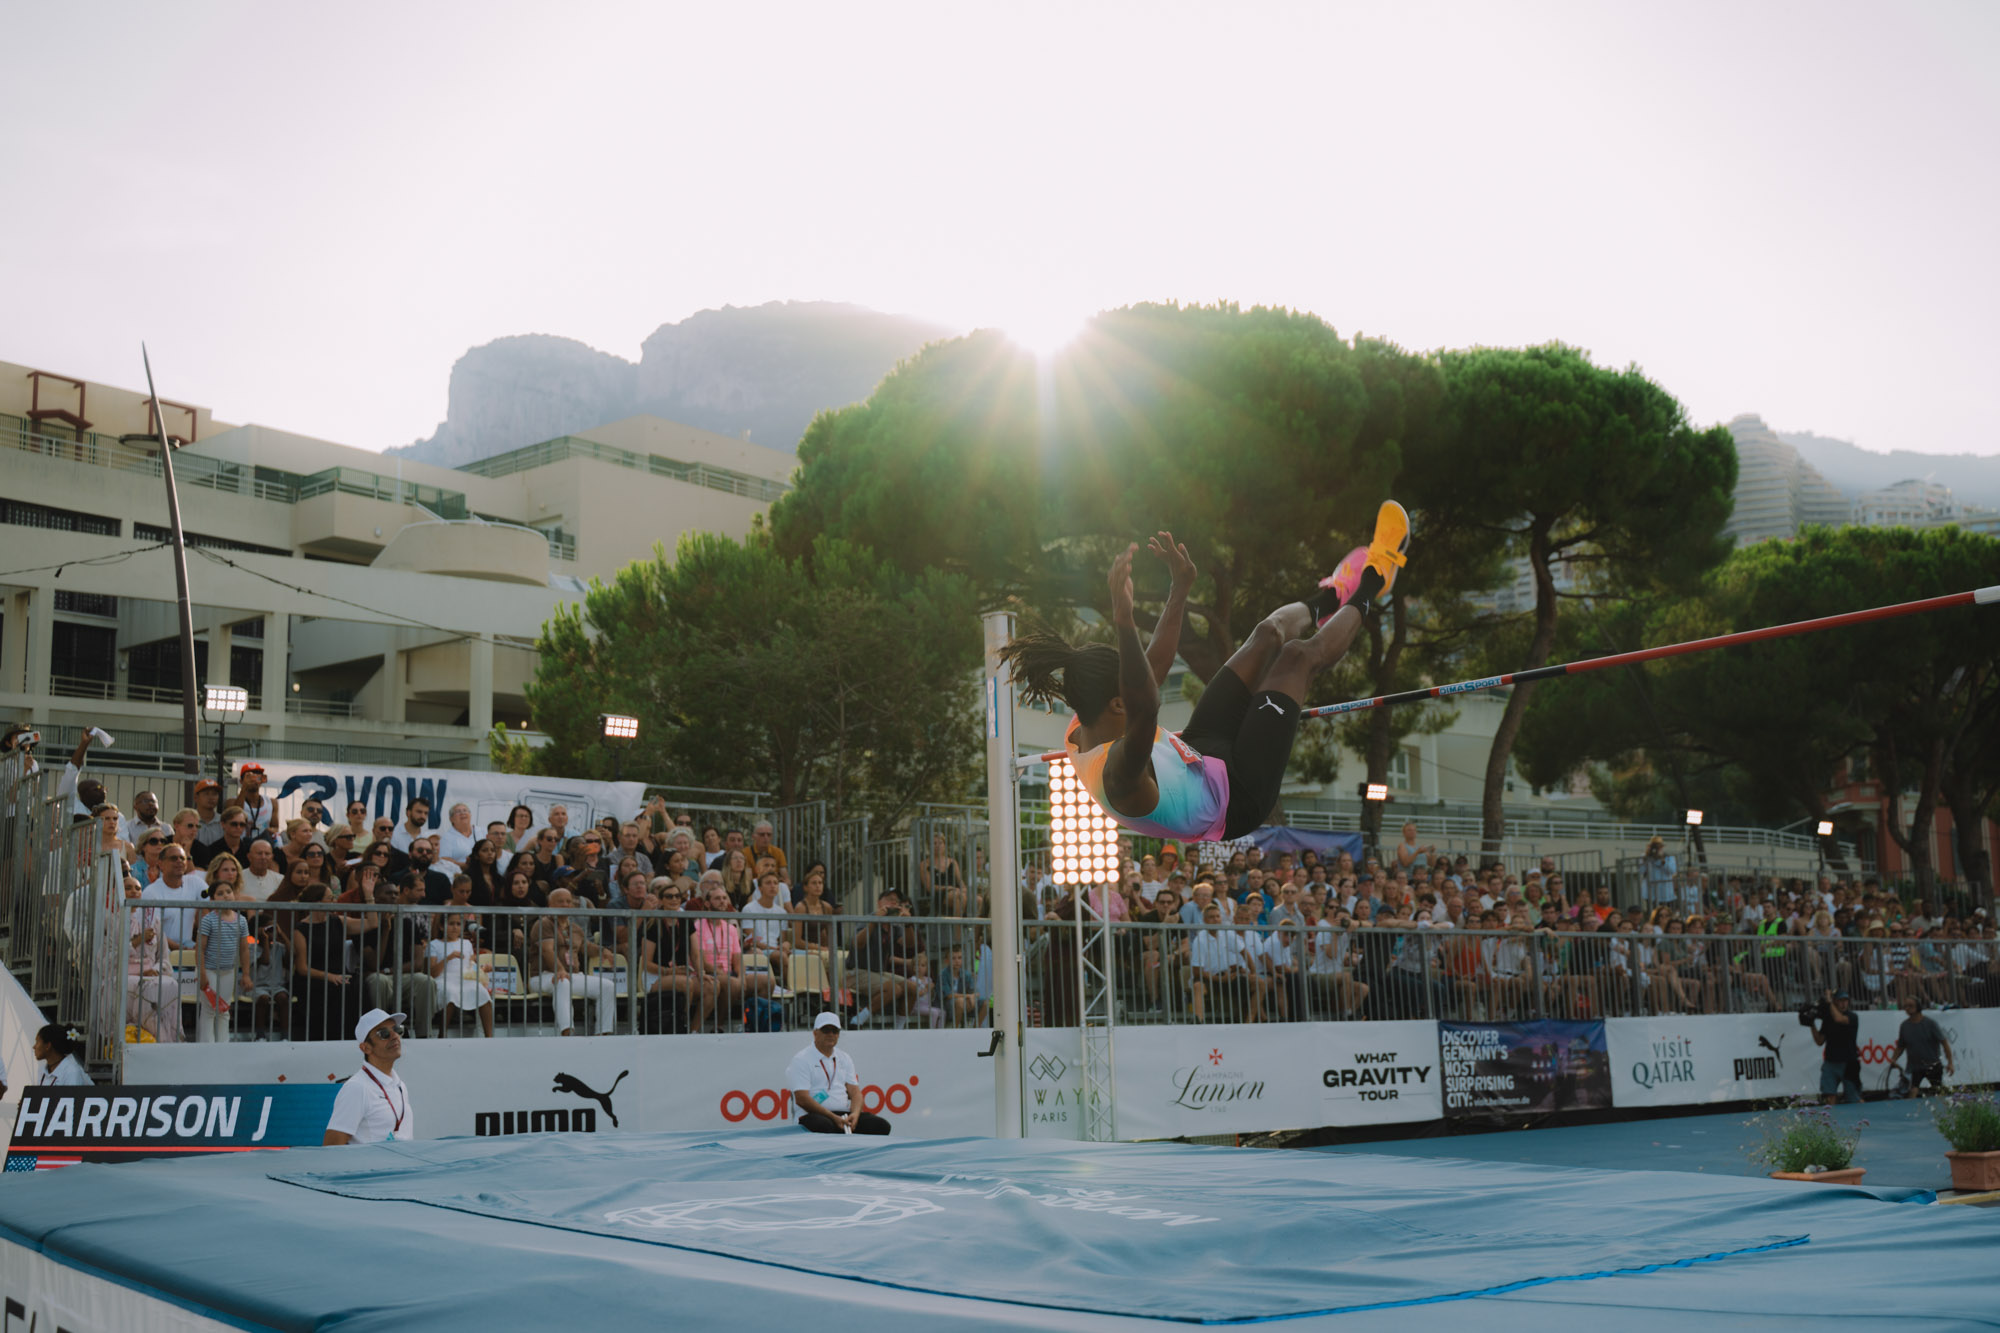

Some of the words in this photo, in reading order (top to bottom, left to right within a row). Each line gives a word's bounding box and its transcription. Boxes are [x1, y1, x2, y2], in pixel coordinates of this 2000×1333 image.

[1442, 1030, 1499, 1045] DISCOVER
[1443, 1044, 1508, 1061] GERMANY'S
[1653, 1035, 1692, 1058] visit
[1354, 1052, 1397, 1063] WHAT
[1323, 1066, 1431, 1087] GRAVITY
[1444, 1061, 1476, 1076] MOST
[1632, 1060, 1695, 1089] QATAR
[1733, 1056, 1776, 1081] PUMA
[1169, 1065, 1265, 1110] Lanson
[1446, 1075, 1515, 1092] SURPRISING
[1358, 1089, 1398, 1101] TOUR
[1446, 1092, 1473, 1108] CITY:
[14, 1095, 242, 1137] HARRISON
[251, 1096, 273, 1141] J
[1033, 1111, 1067, 1123] PARIS
